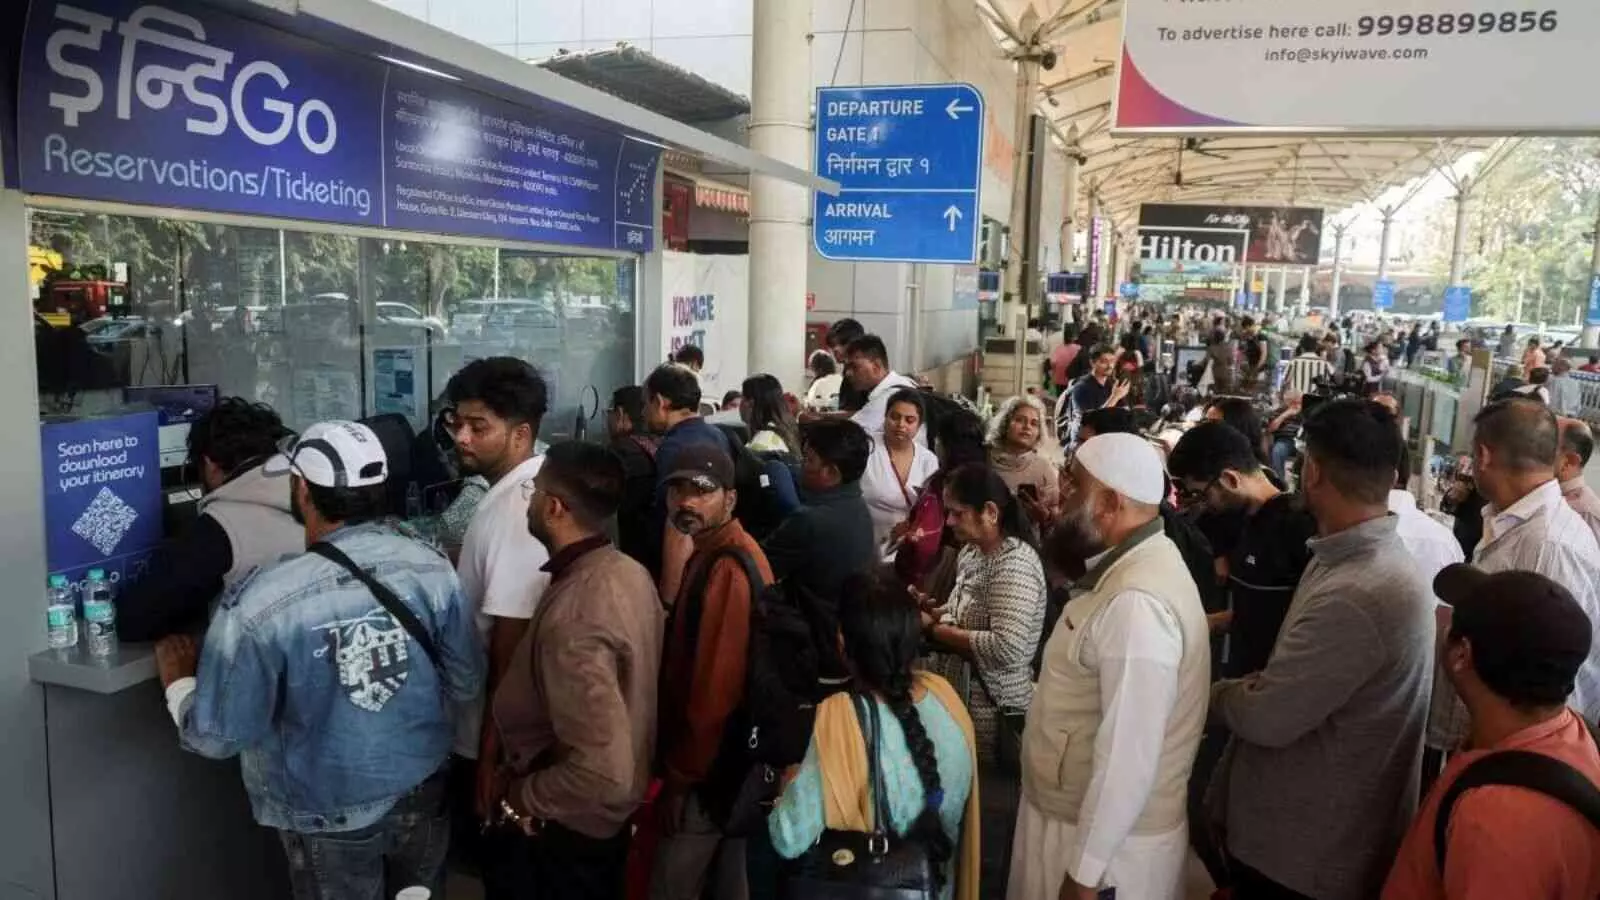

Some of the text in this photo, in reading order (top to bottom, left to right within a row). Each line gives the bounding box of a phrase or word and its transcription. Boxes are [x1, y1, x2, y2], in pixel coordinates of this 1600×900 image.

[1157, 9, 1558, 41] To advertise here call: 9998899856
[1264, 46, 1429, 63] info@skyiwave.com
[827, 99, 924, 117] DEPARTURE
[827, 126, 867, 142] GATE
[44, 133, 372, 217] Reservations/Ticketing
[826, 152, 931, 178] निर्गमन द्वार १
[825, 203, 893, 218] ARRIVAL
[824, 229, 877, 247] आगमन
[1135, 236, 1236, 262] Hilton
[57, 435, 139, 457] Scan here to
[58, 450, 128, 474] download
[60, 463, 146, 493] your itinerary
